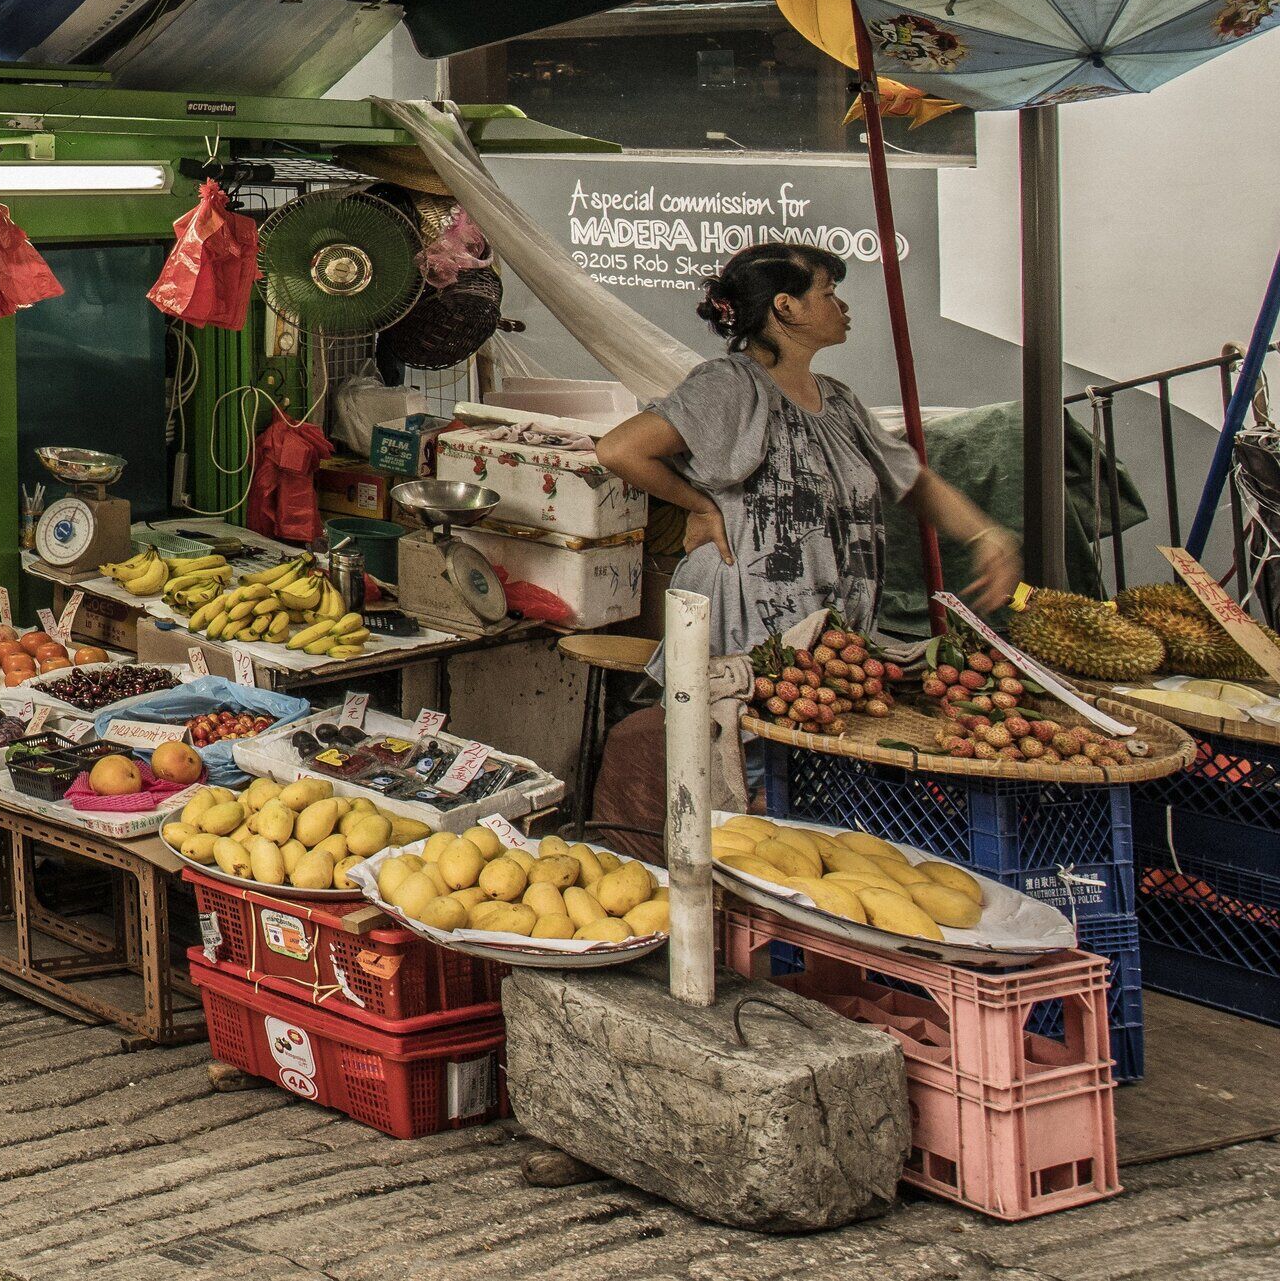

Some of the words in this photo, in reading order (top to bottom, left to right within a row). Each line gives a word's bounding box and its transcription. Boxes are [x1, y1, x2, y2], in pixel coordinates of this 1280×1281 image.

[188, 103, 235, 113] #CUTogether
[568, 179, 589, 216] A
[590, 186, 655, 219] special
[660, 191, 774, 217] commission
[777, 182, 811, 226] for
[570, 217, 697, 253] MADERA
[634, 254, 668, 272] Rob
[1085, 885, 1102, 894] WILL
[288, 1073, 309, 1093] 4A
